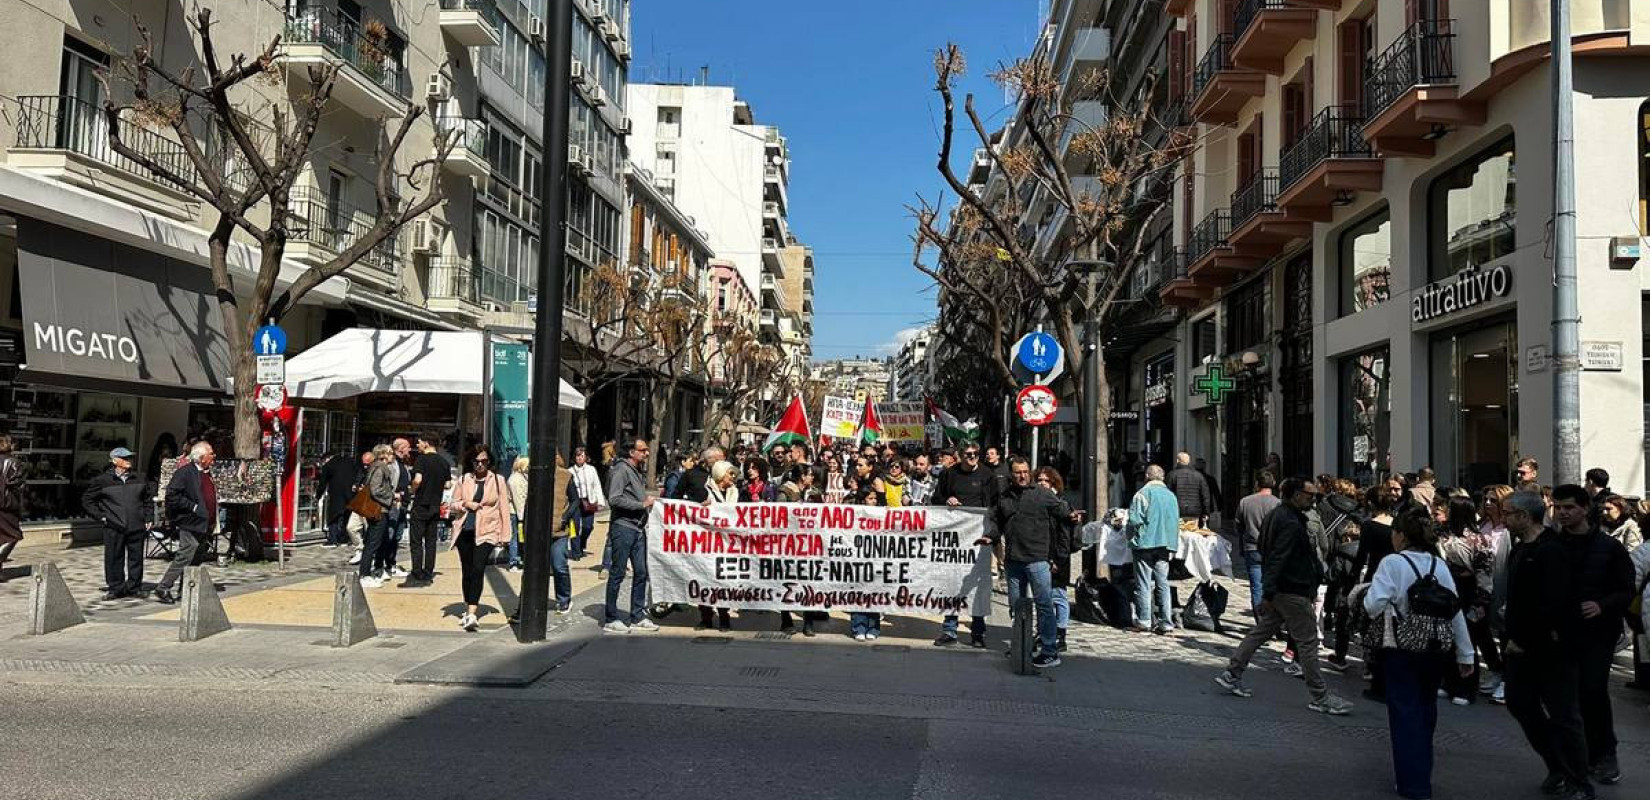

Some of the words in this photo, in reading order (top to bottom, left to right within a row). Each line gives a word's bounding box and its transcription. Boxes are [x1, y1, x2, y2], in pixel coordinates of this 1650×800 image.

[1412, 260, 1508, 322] attrattivo
[33, 322, 135, 362] MIGATO
[1110, 411, 1138, 419] OSMOS
[663, 503, 710, 526] ΚΑΤΩ
[711, 517, 730, 528] τα
[735, 505, 789, 529] ΧΕΡΙΑ
[820, 506, 855, 529] ΛΑΟ
[858, 517, 881, 530] του
[884, 509, 926, 531] ΙΡΑΝ
[663, 529, 724, 554] ΚΑΜΙΑ
[727, 533, 824, 556] ΣΥΝΕΡΓΑΣΙΑ
[854, 535, 928, 559] ΦΟΝΙΑΔΕΣ
[931, 531, 959, 548] ΗΠΑ
[827, 546, 853, 558] τους
[931, 548, 977, 565] ΙΣΡΑΗΛ
[715, 557, 751, 580] ΕΞΩ
